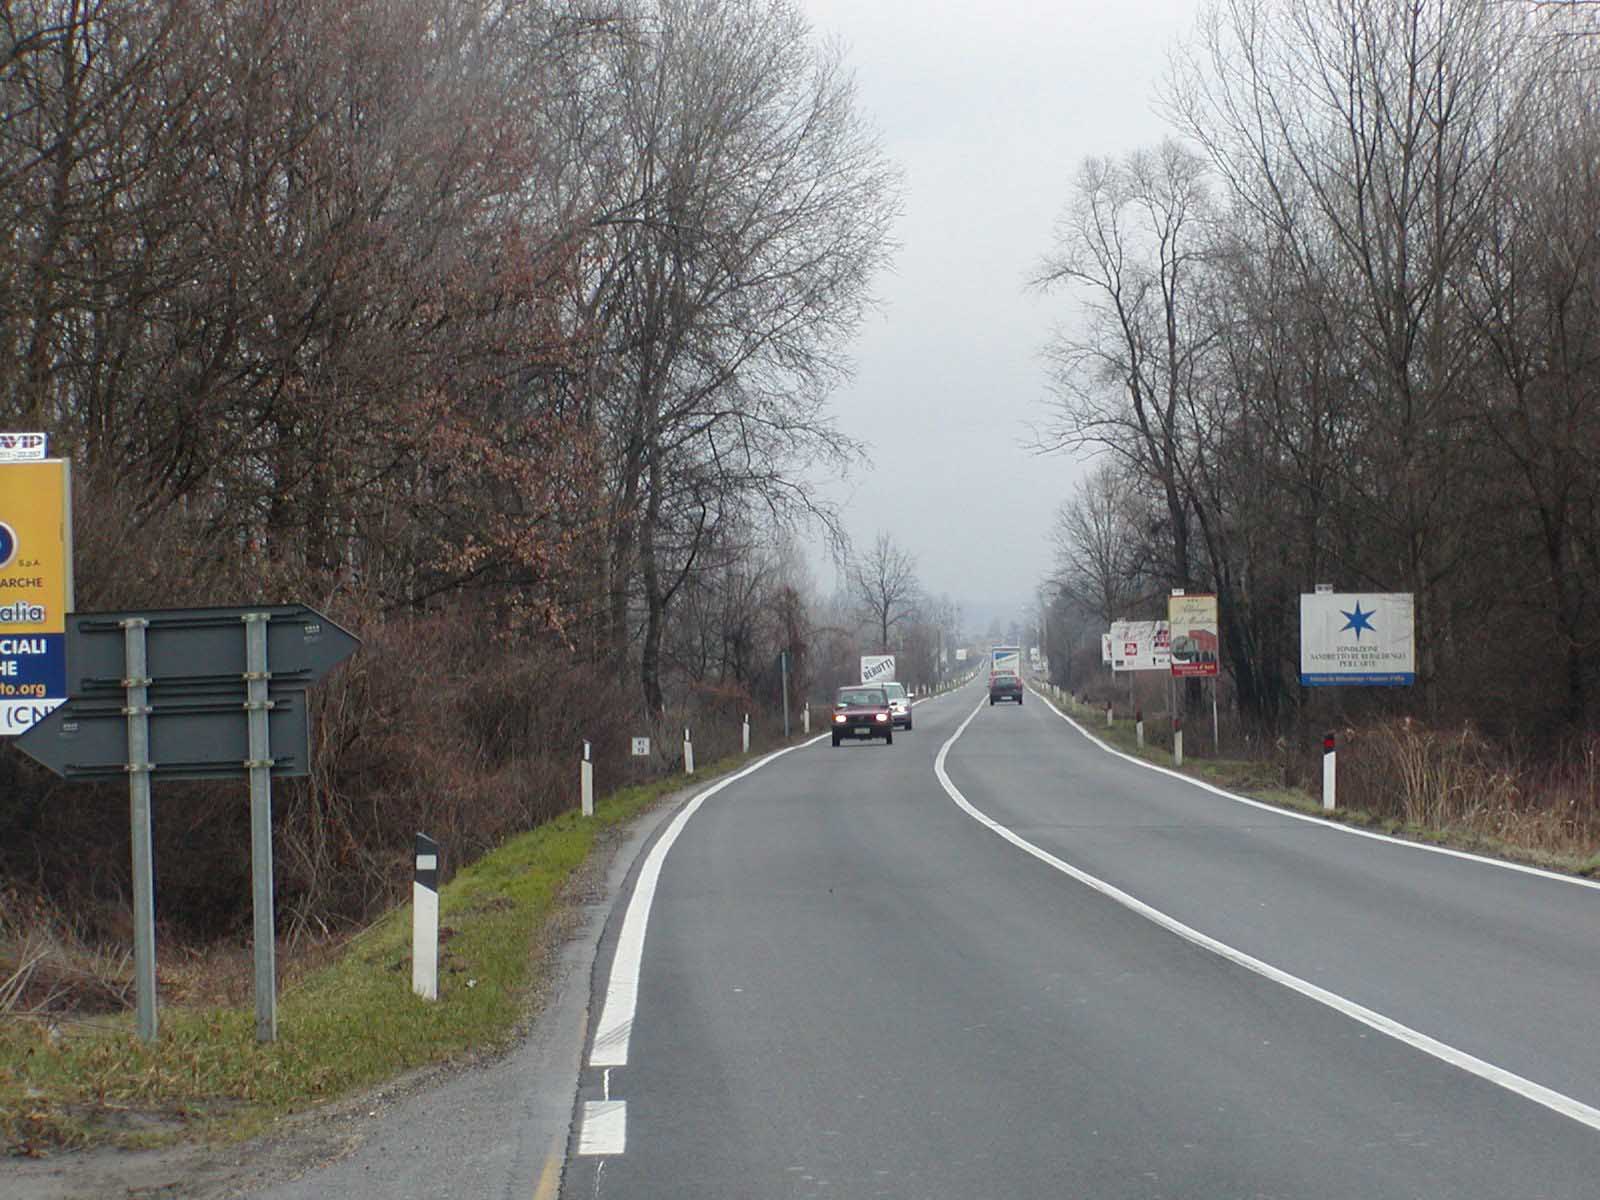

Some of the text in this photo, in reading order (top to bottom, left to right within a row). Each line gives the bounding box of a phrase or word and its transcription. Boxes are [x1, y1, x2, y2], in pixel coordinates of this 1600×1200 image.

[0, 577, 43, 588] ARCHE
[0, 602, 42, 621] alia
[0, 639, 47, 654] CIALI
